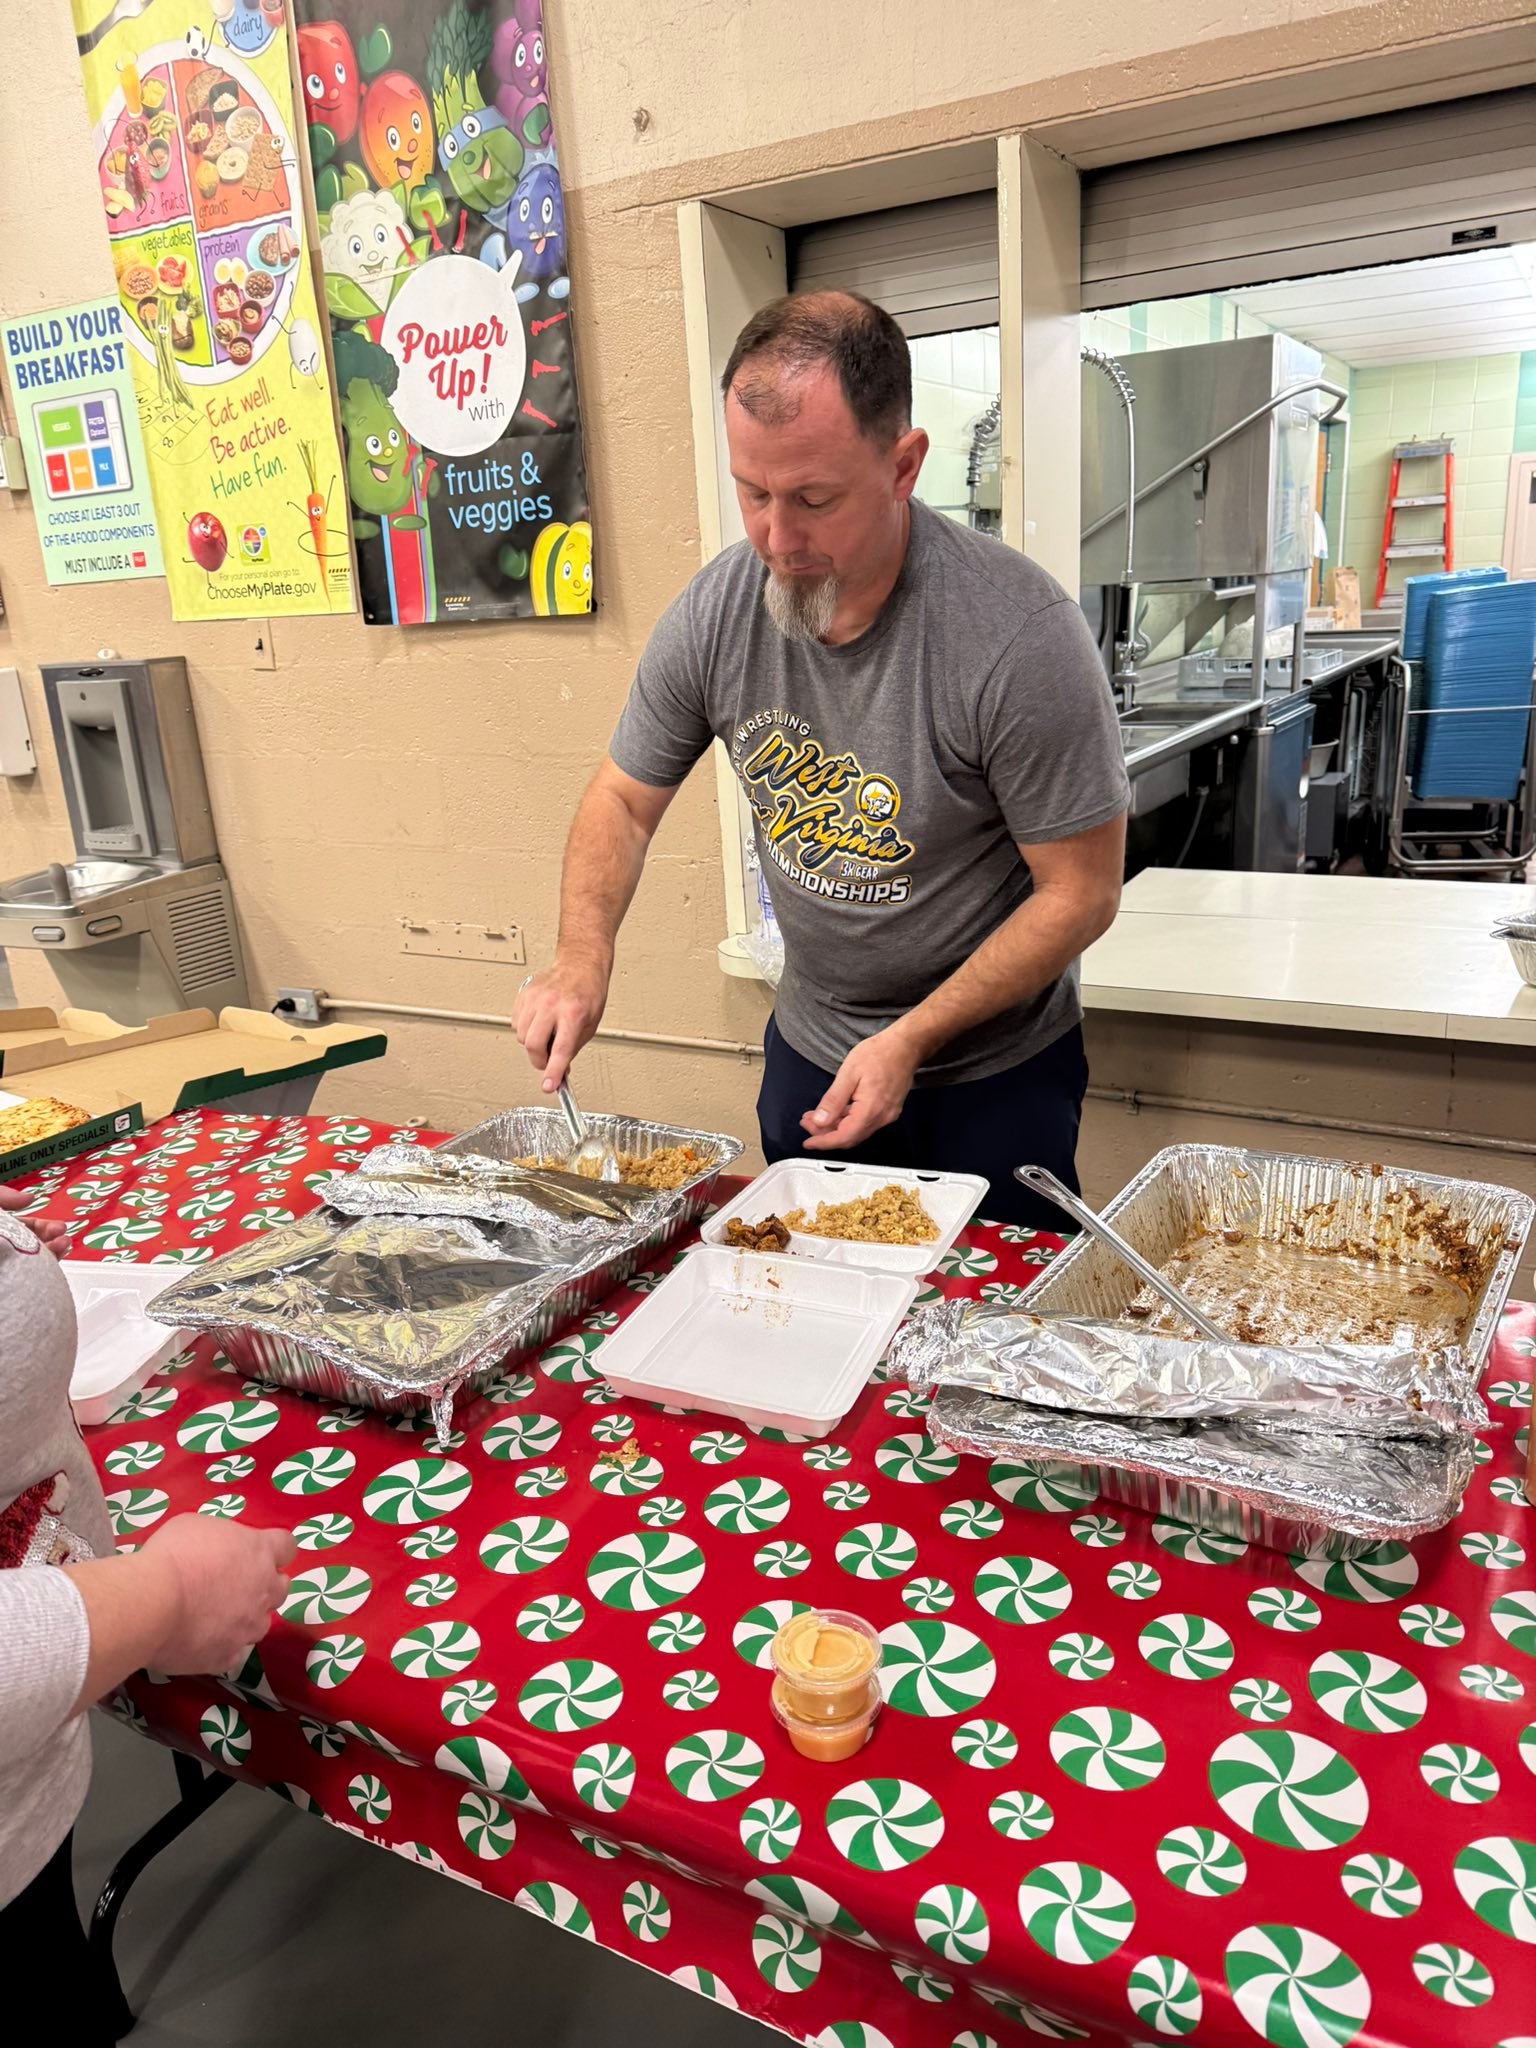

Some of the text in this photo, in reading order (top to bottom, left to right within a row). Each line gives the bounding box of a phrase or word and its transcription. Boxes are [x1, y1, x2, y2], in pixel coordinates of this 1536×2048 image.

[234, 13, 263, 40] dairy
[160, 192, 186, 216] fruits
[198, 198, 229, 228] grains
[141, 227, 193, 259] vegetables
[203, 235, 240, 260] protein
[6, 306, 123, 356] BUILD YOUR
[397, 315, 508, 363] Power
[15, 342, 125, 390] BREAKFAST
[428, 353, 492, 410] Up!
[205, 376, 275, 428] Eat well.
[468, 398, 505, 421] with
[209, 417, 291, 464] Be active.
[209, 452, 287, 499] Have fun.
[444, 451, 542, 496] fruits &
[48, 503, 140, 525] CHOOSE AT LEAST 3 OUT
[448, 490, 553, 533] veggies
[43, 524, 155, 547] OF THE 4 FOOD COMPONENTS
[64, 558, 87, 574] MUST
[88, 555, 123, 571] INCLUDE
[124, 555, 132, 569] A
[230, 573, 243, 582] your
[244, 569, 268, 580] personal
[270, 569, 282, 579] plan
[284, 570, 291, 578] go
[207, 581, 317, 600] ChooseMyPlate.gov
[736, 709, 811, 743] WRESTLING
[744, 732, 862, 798] West
[769, 793, 914, 869] Virginia
[855, 866, 880, 880] GEAR
[30, 1143, 56, 1162] ONLY
[59, 1124, 110, 1151] SPECIALS!
